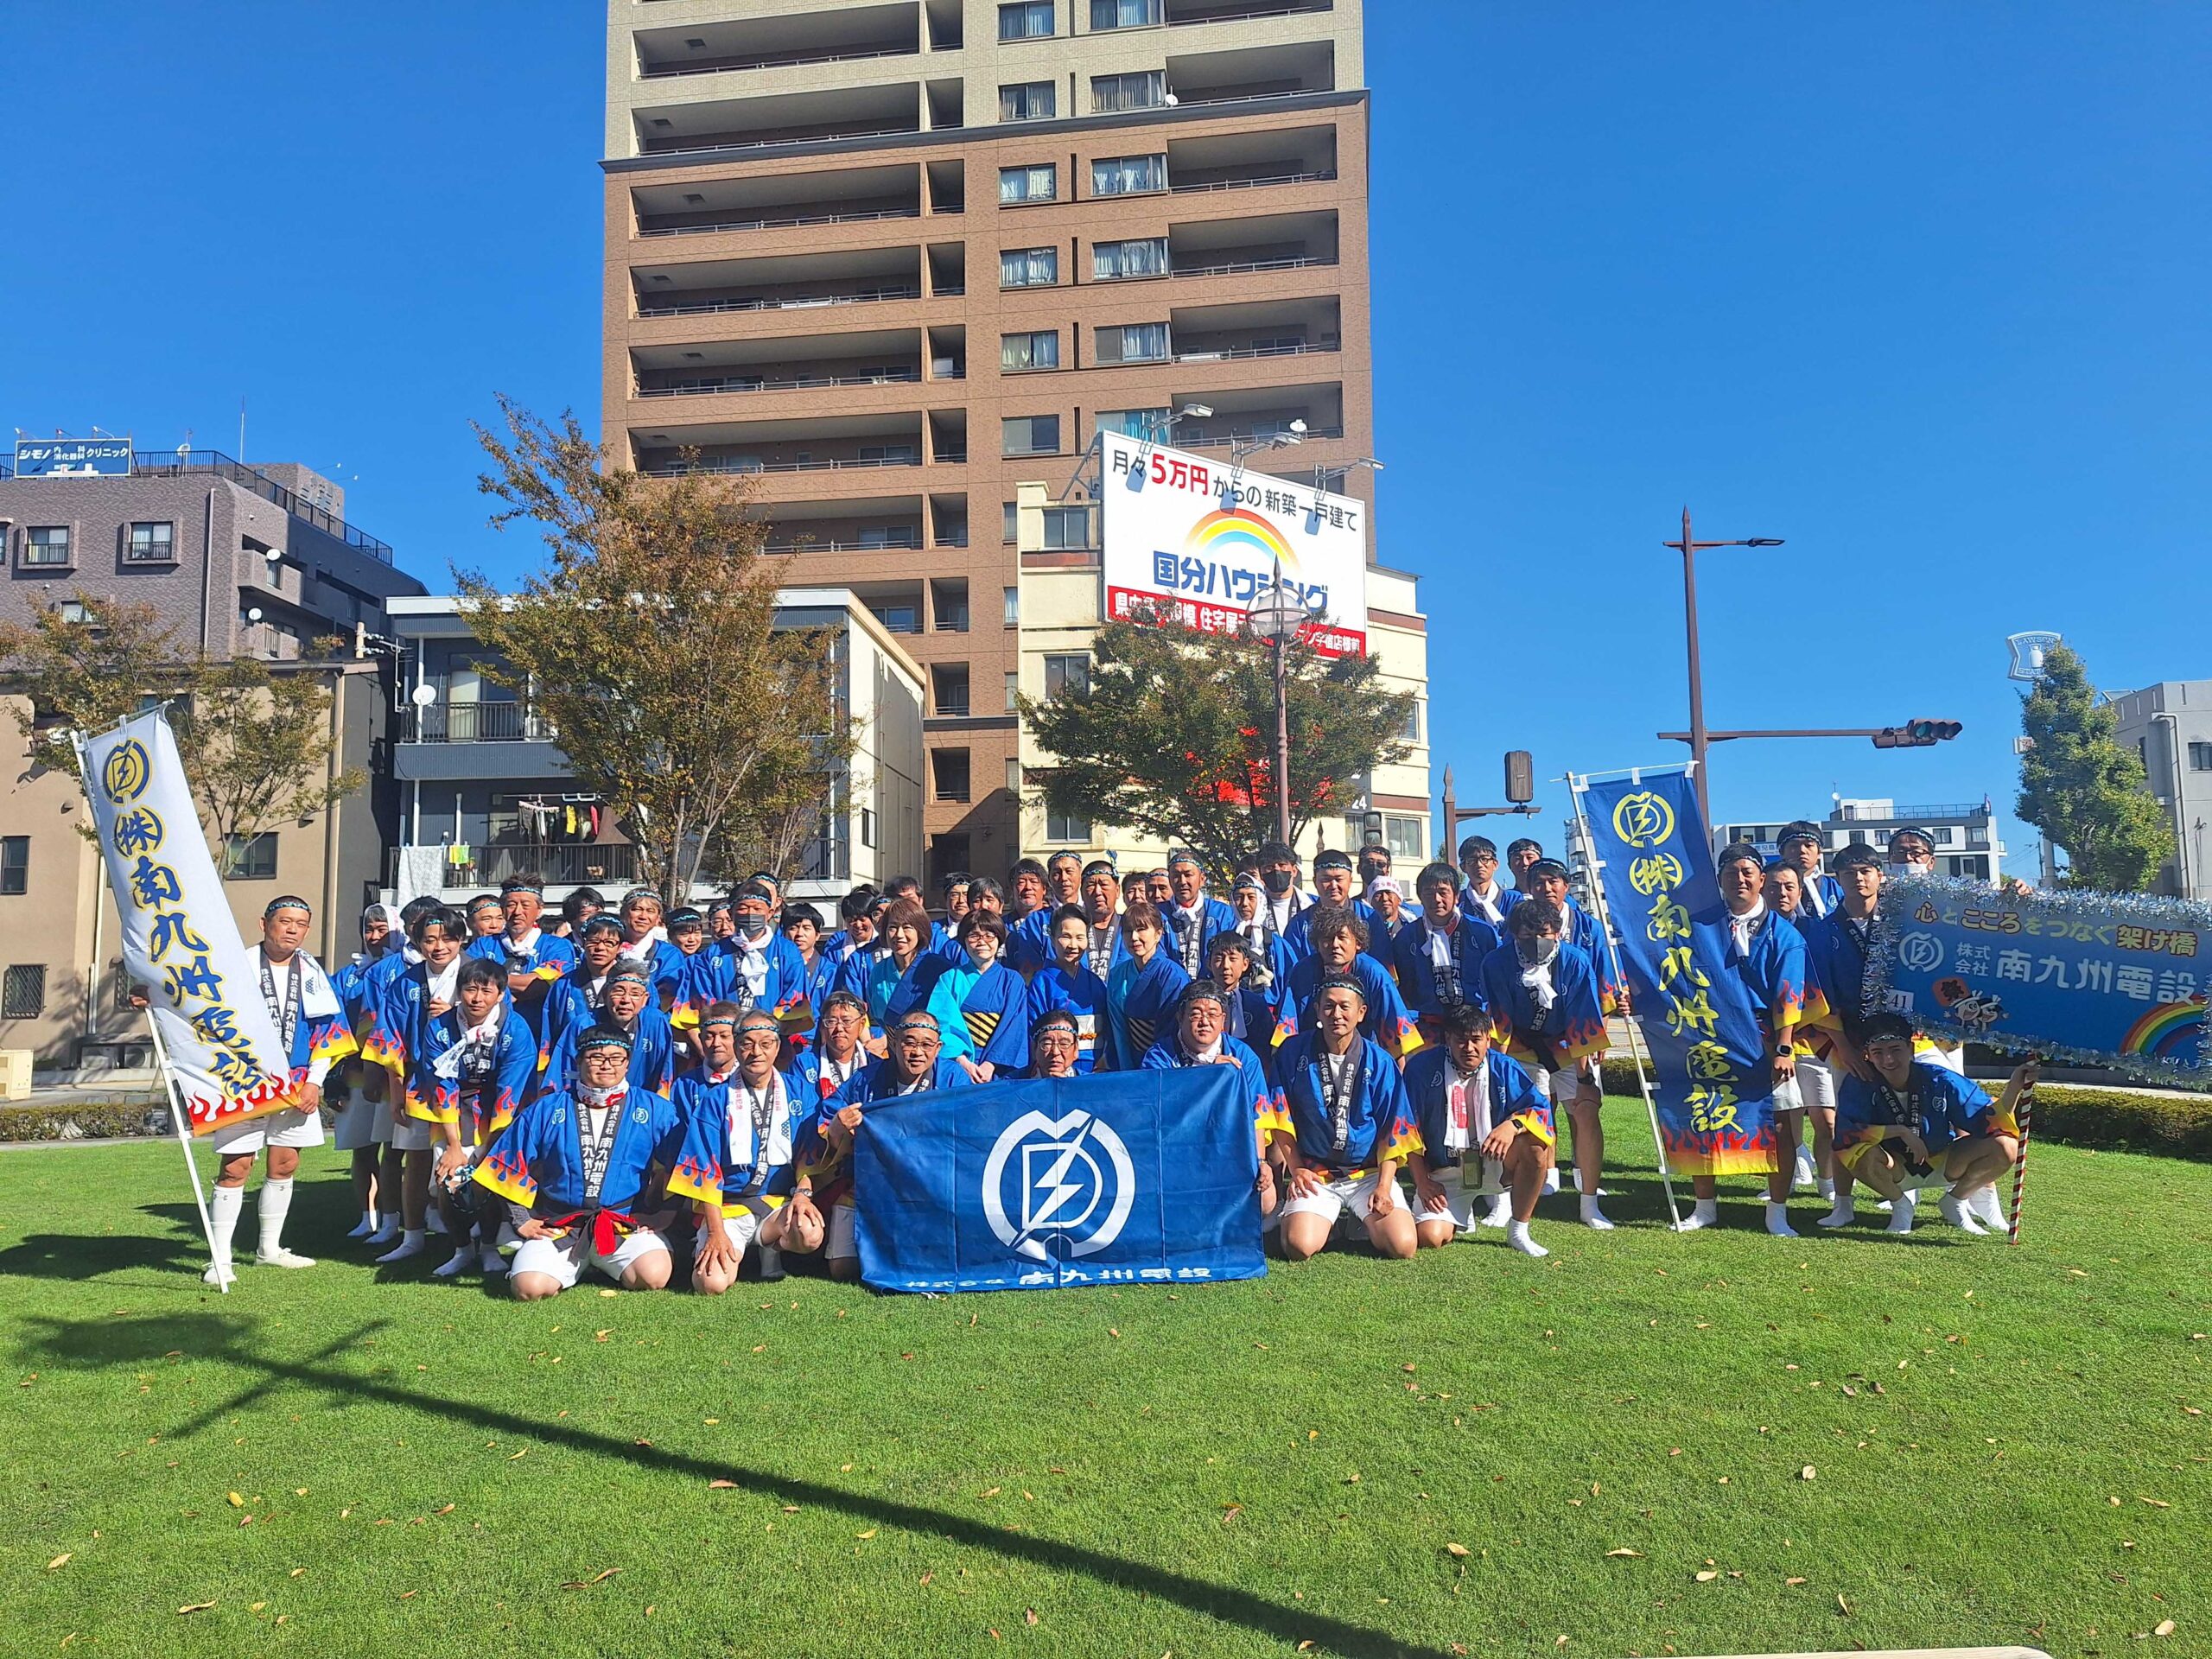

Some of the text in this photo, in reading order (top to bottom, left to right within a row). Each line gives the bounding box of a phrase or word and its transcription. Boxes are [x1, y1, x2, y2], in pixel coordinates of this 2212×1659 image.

[19, 447, 129, 460] シモノ クリニック
[1996, 948, 2197, 1006] 南九州電設
[577, 1103, 591, 1133] 株式会社
[1332, 1063, 1355, 1151] 株式会社 南九州電設
[585, 1104, 620, 1198] 株式会社 南九州電設
